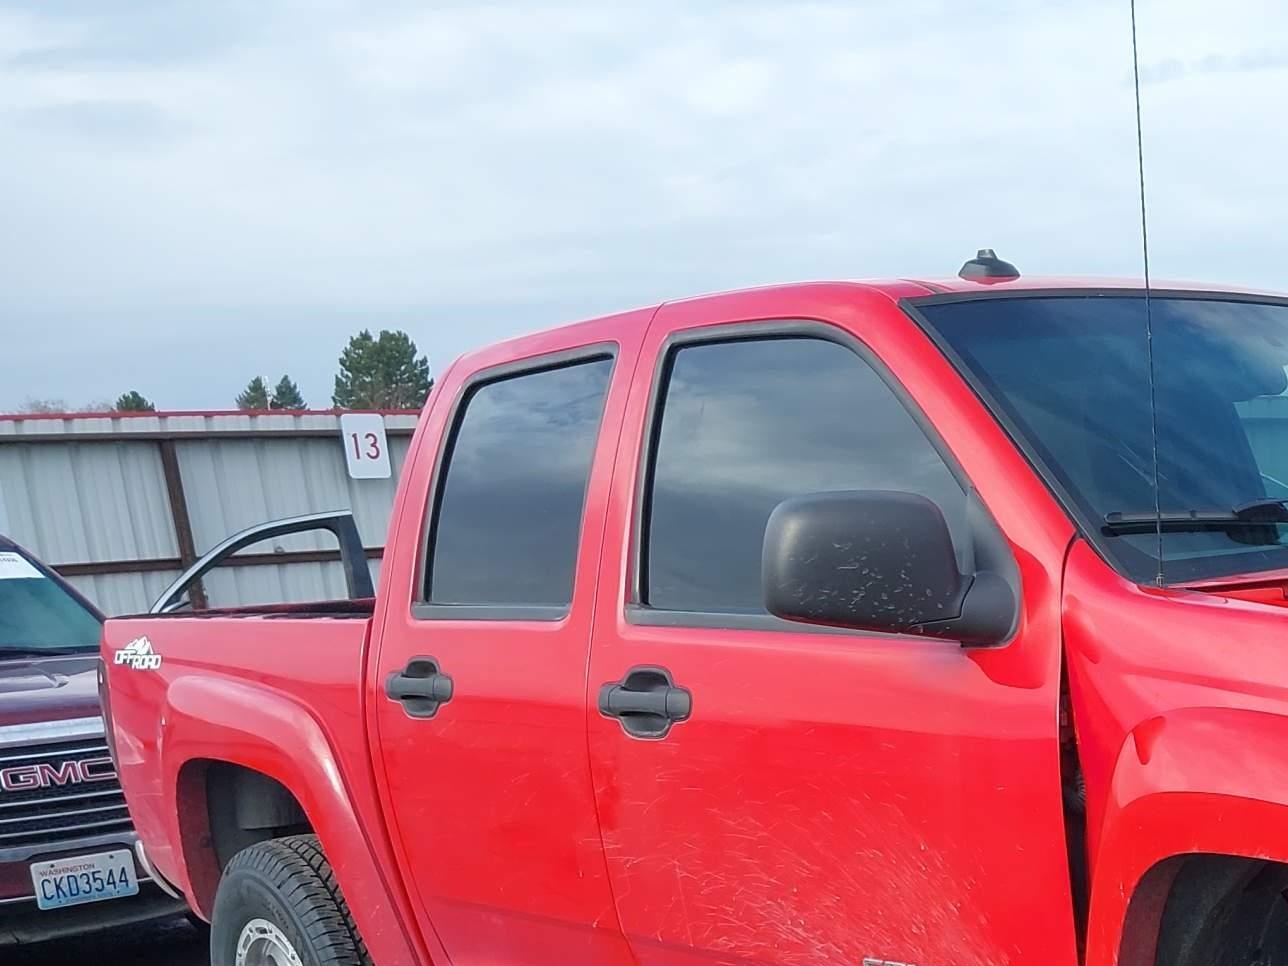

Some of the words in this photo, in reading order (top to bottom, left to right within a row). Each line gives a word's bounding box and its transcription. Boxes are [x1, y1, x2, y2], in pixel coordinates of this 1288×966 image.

[351, 432, 381, 461] 13
[0, 757, 118, 791] GMC
[40, 863, 96, 877] WASHINGTON
[41, 866, 130, 901] CKD3544
